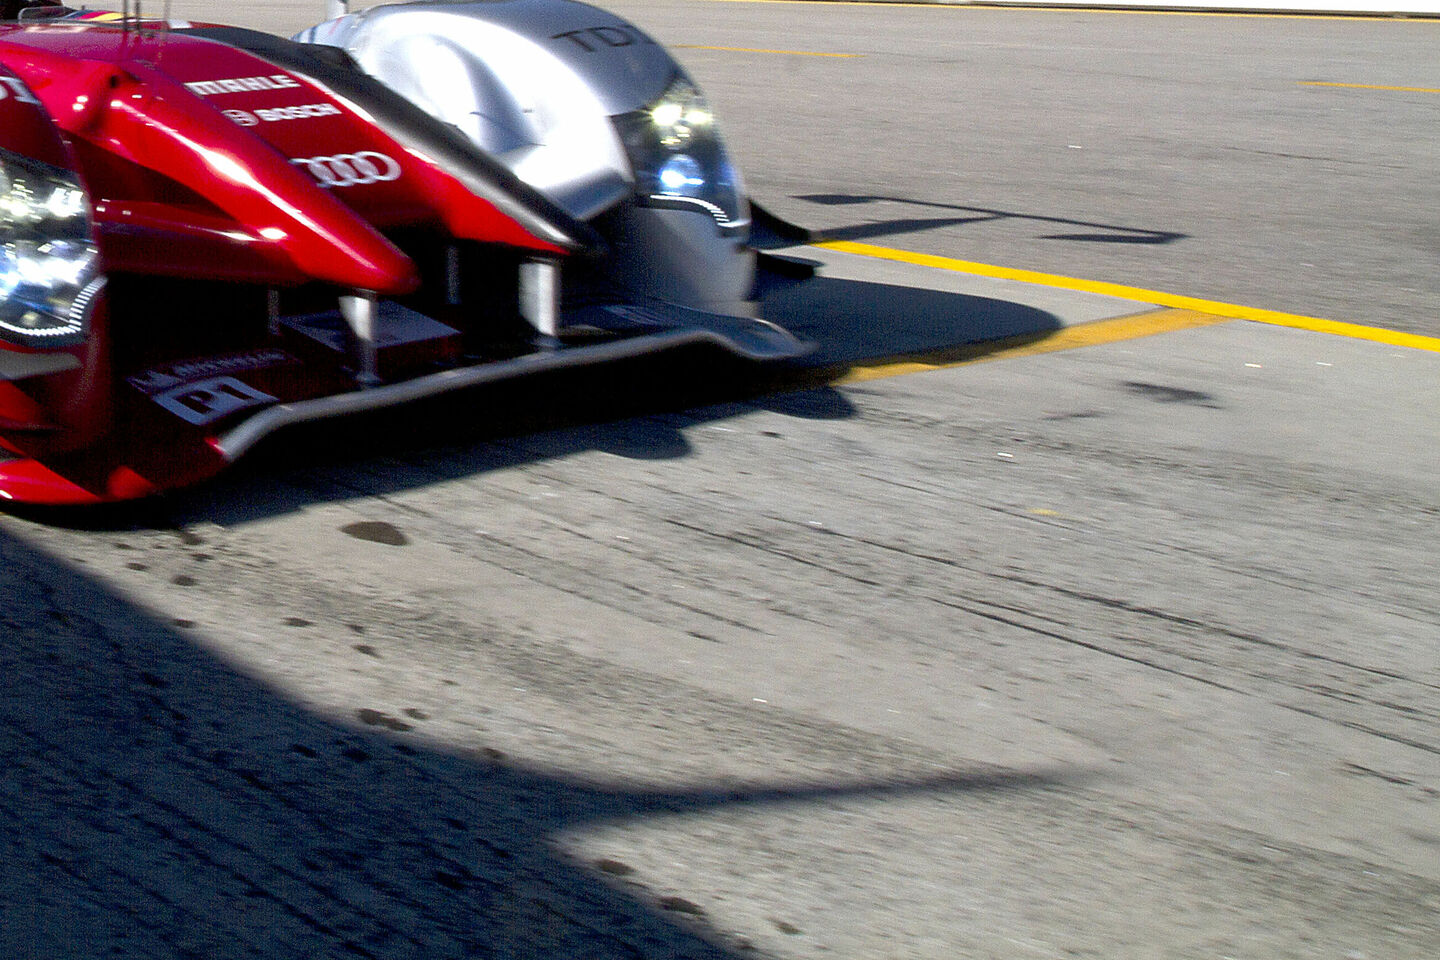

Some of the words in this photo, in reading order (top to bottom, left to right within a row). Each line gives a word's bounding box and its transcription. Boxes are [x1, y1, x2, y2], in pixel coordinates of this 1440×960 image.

[184, 74, 301, 96] MAHLE
[253, 103, 342, 121] BOSCH
[172, 383, 255, 414] P1
